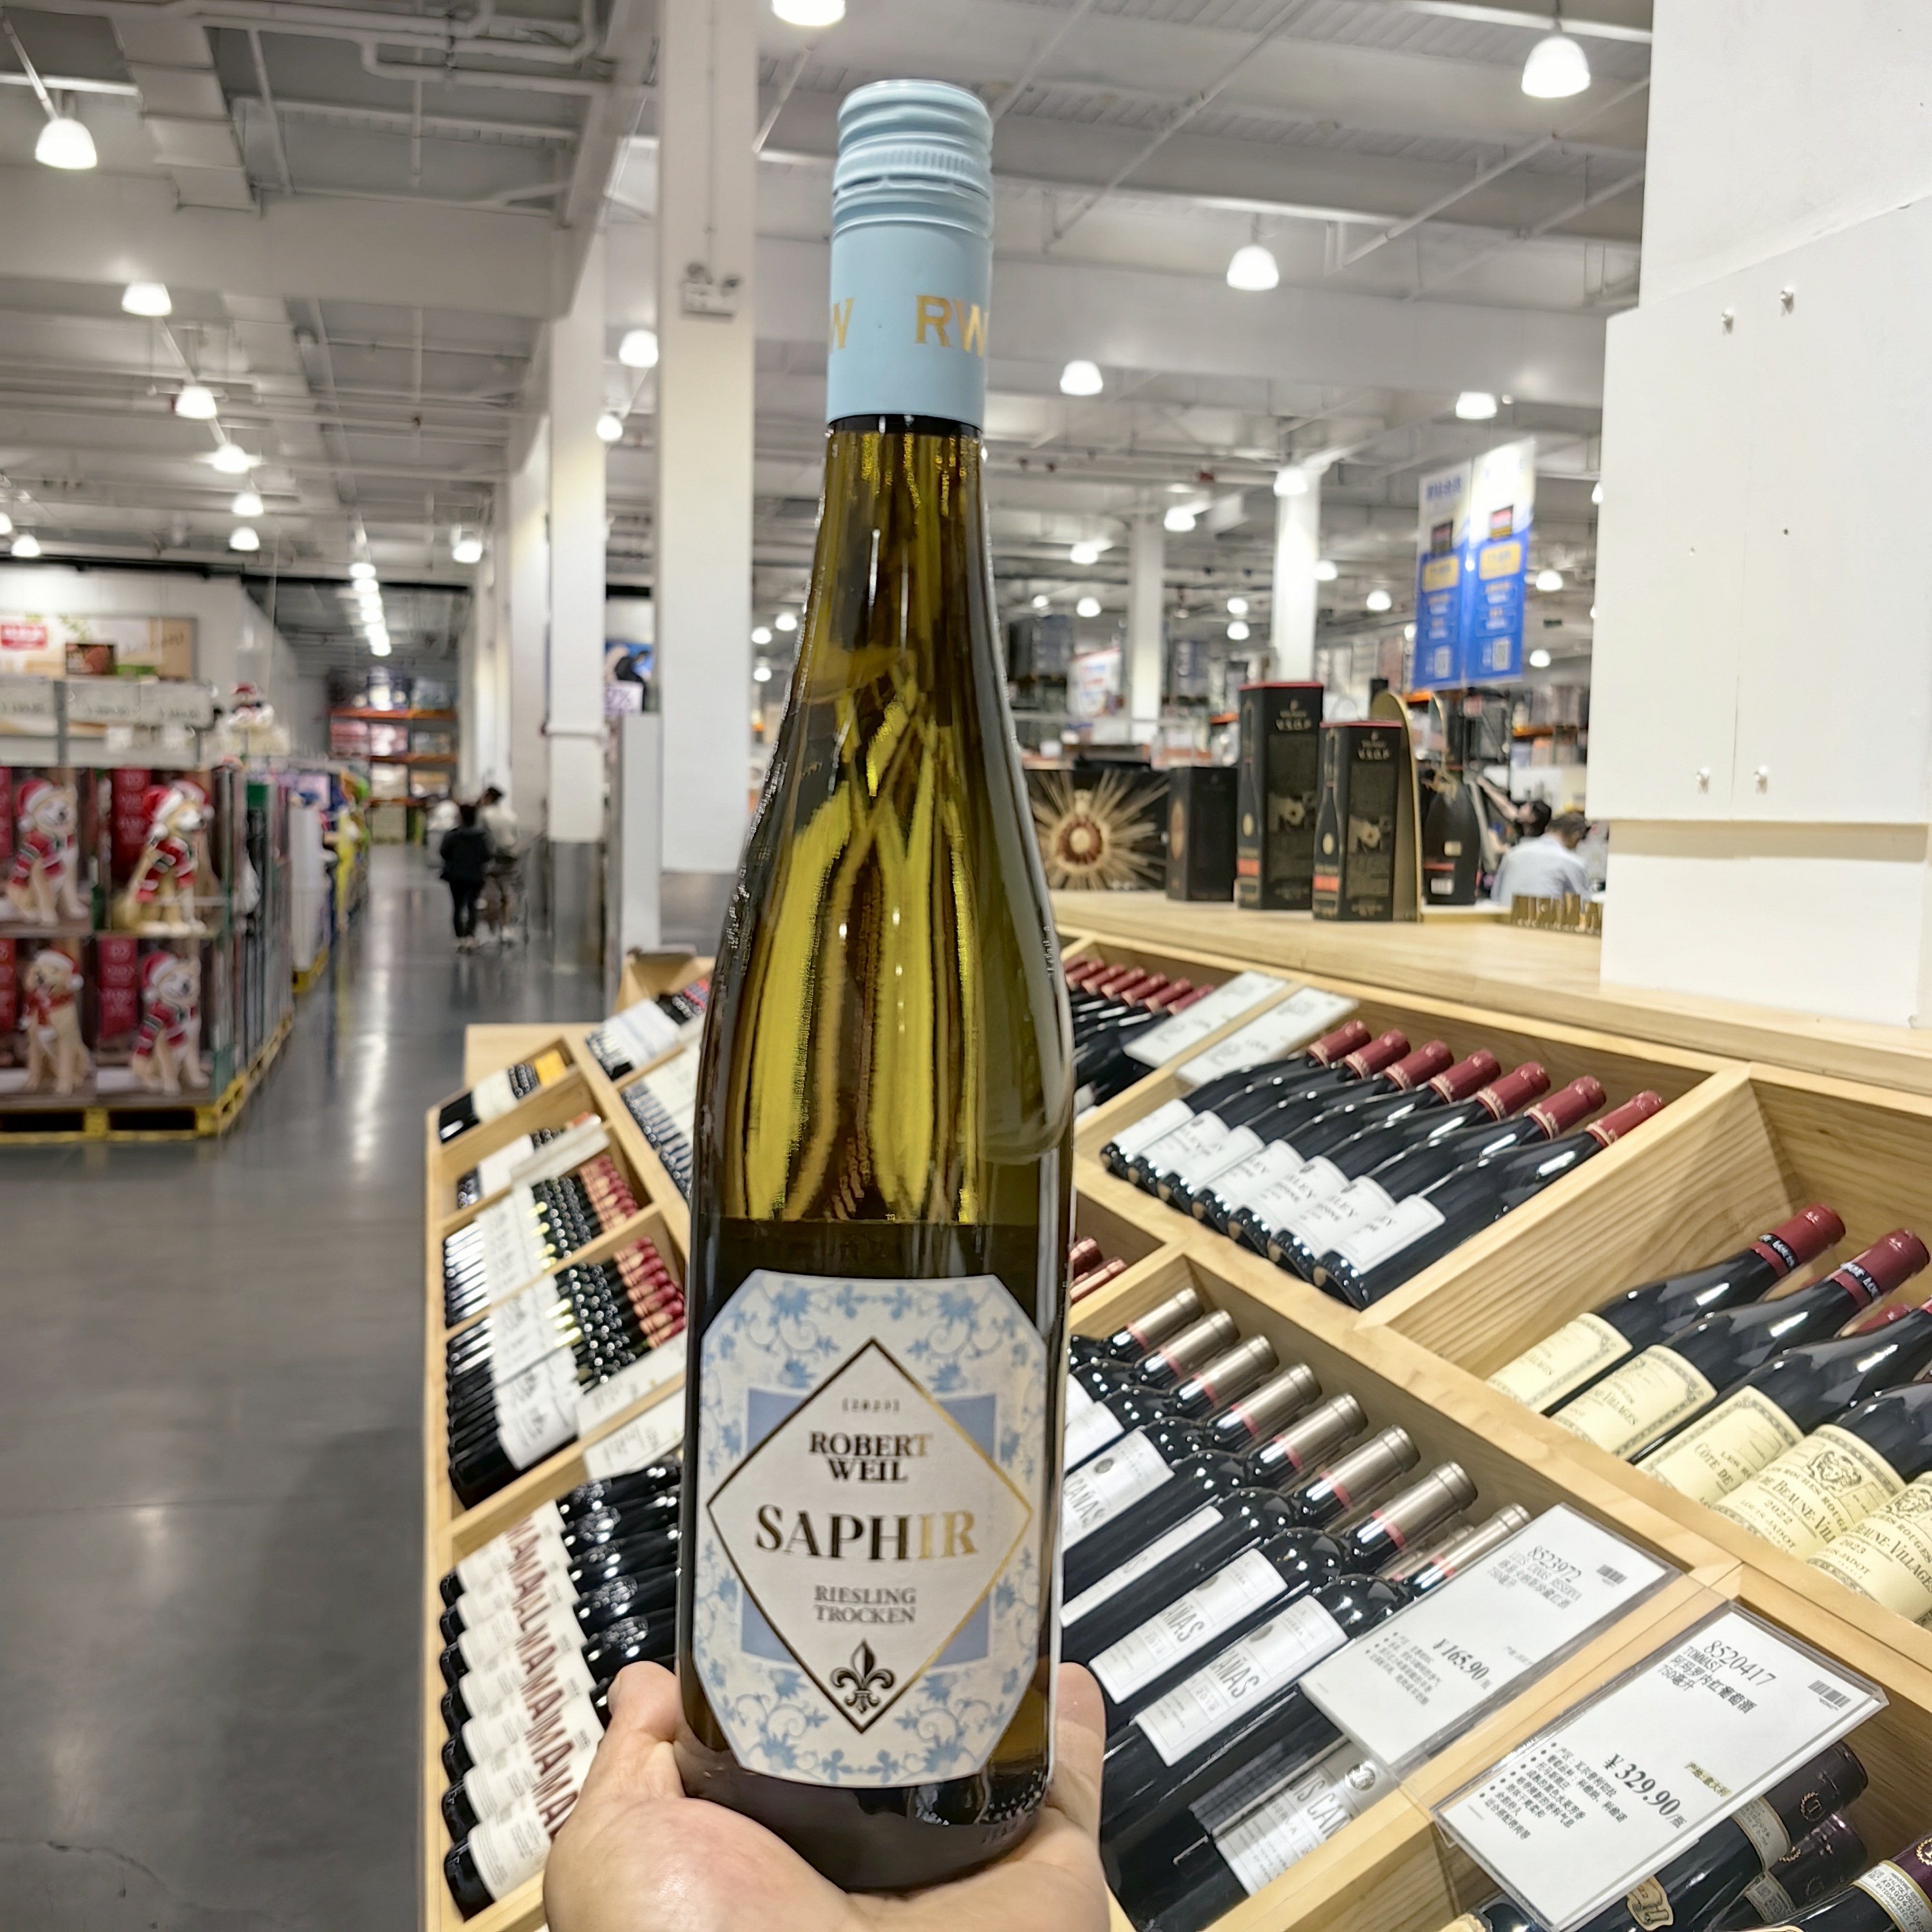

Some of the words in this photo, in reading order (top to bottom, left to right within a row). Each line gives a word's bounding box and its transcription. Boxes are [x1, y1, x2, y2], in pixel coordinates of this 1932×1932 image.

[809, 1430, 933, 1457] ROBERT
[826, 1457, 908, 1483] WEIL
[1763, 1499, 1793, 1526] 2022
[755, 1504, 979, 1562] SAPHIR
[1765, 1519, 1797, 1550] JADOT
[1897, 1523, 1931, 1565] ROUGES
[1839, 1553, 1871, 1575] JADOT
[814, 1584, 917, 1605] RIESLING
[813, 1604, 916, 1624] TROCKEN
[1683, 1645, 1723, 1673] TOMMASI
[1703, 1640, 1777, 1686] 8520417
[1656, 1663, 1696, 1692] 750毫升
